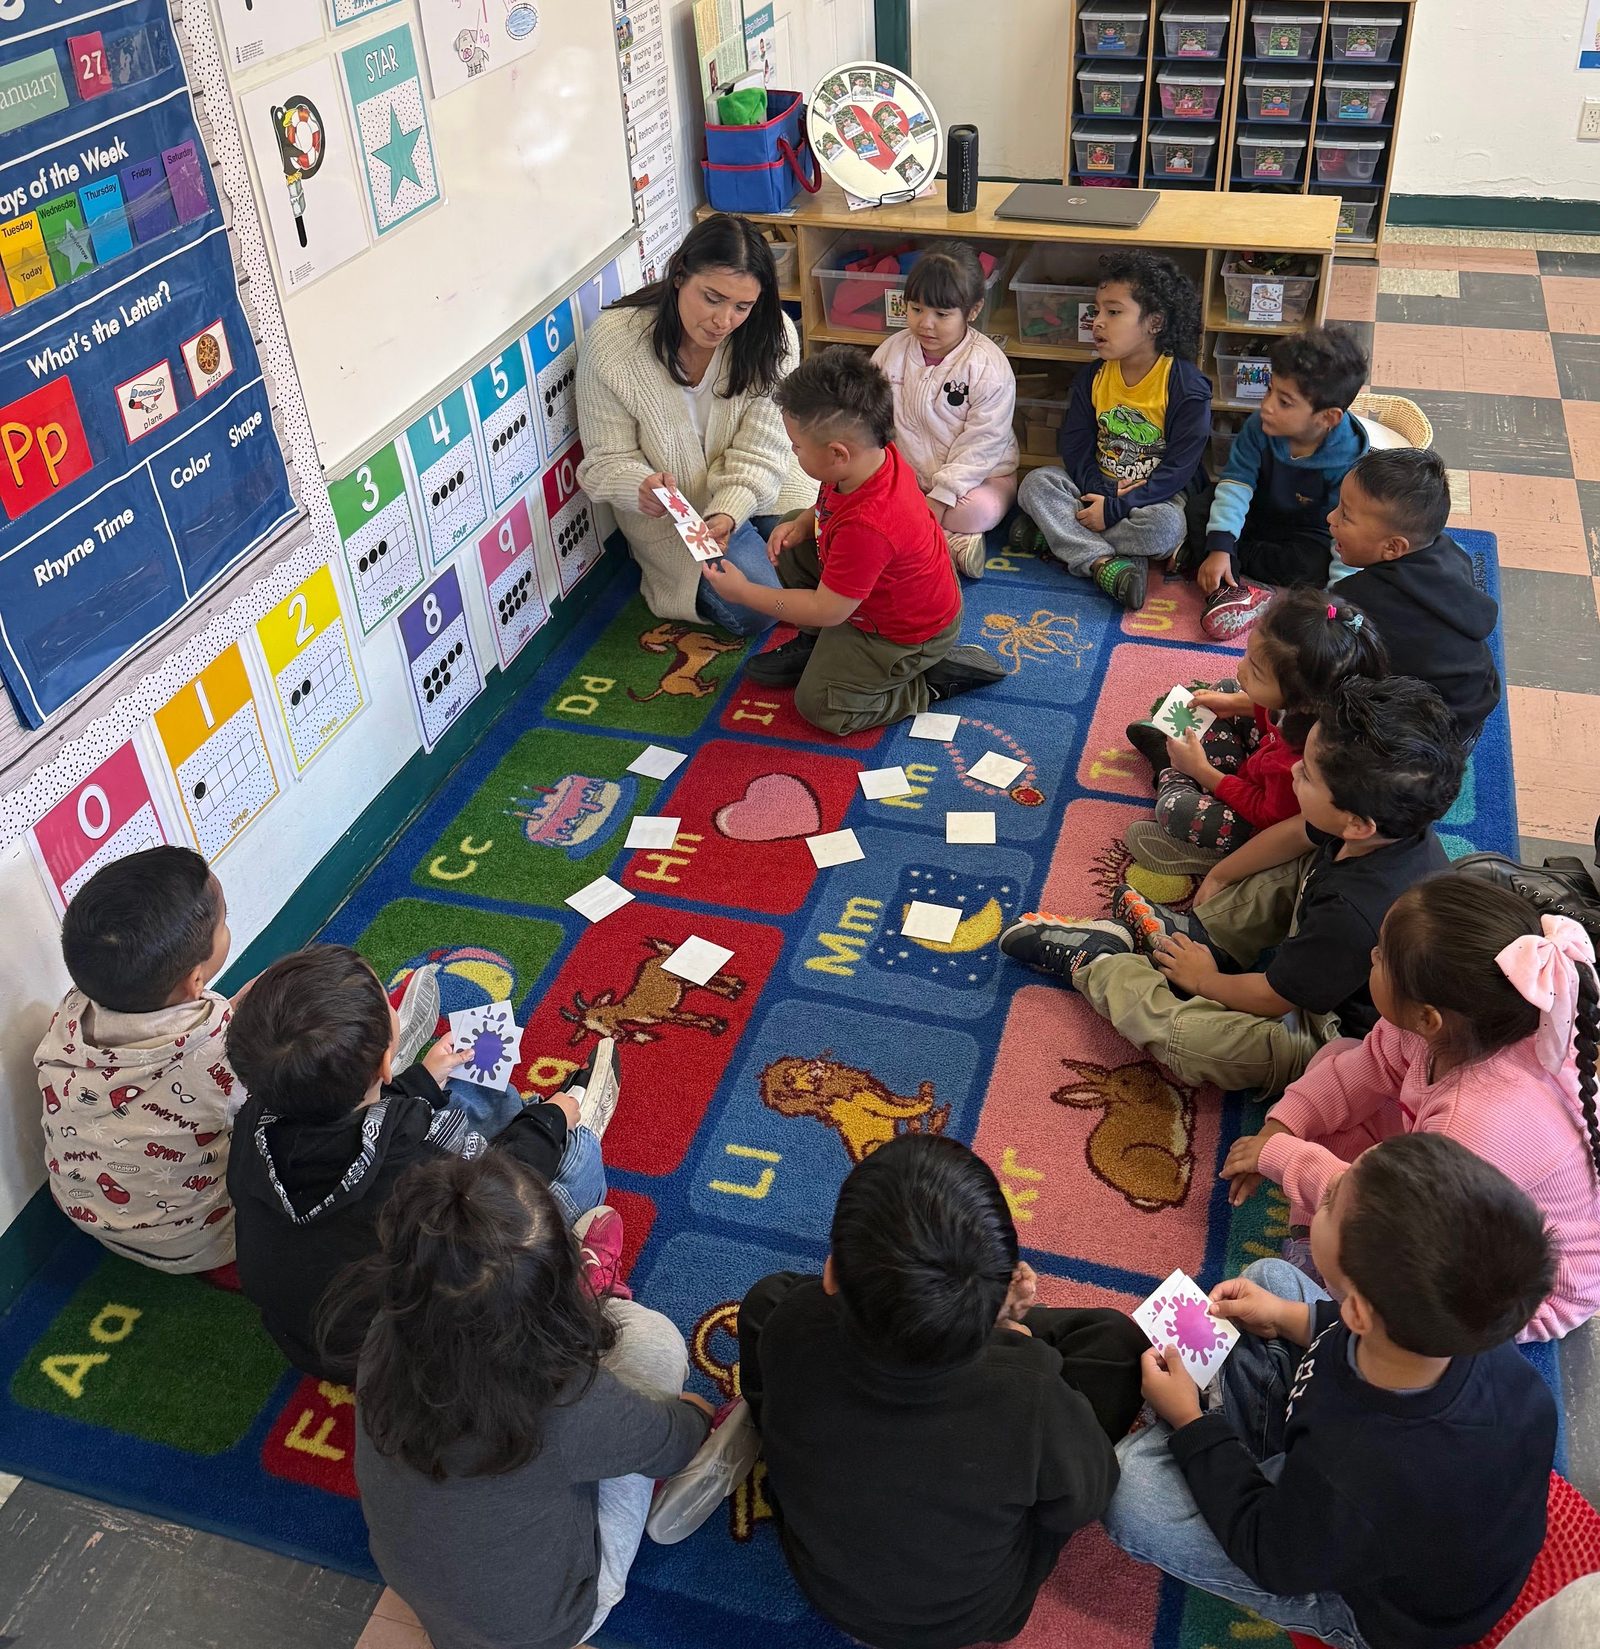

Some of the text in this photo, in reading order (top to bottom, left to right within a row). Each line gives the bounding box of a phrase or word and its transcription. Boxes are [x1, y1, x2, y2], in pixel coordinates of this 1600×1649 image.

[79, 50, 104, 80] 27
[364, 43, 400, 84] STAR
[631, 94, 647, 110] Lunch
[646, 88, 656, 100] Time
[638, 121, 659, 141] Restroom
[30, 168, 50, 198] of
[50, 160, 80, 191] the
[79, 136, 129, 172] Week
[166, 146, 194, 165] Saturday
[646, 154, 656, 166] Time
[131, 166, 153, 181] Friday
[84, 181, 117, 201] Thursday
[646, 188, 666, 208] Restroom
[39, 198, 77, 220] Wednesday
[1, 218, 33, 240] Tuesday
[645, 230, 661, 246] Snack
[659, 222, 669, 236] Time
[655, 246, 673, 266] Outdoor
[20, 264, 43, 283] Today
[26, 281, 172, 379] What's the Letter?
[544, 313, 560, 353] 6
[206, 370, 222, 386] pizza
[489, 355, 508, 399] 5
[143, 412, 163, 430] plane
[228, 410, 262, 447] Shape
[428, 402, 450, 446] 4
[0, 421, 68, 488] Pp
[170, 452, 213, 489] Color
[356, 464, 380, 512] 3
[509, 470, 524, 486] five
[554, 457, 576, 502] 10
[33, 507, 135, 588] Rhyme Time
[451, 523, 468, 543] four
[498, 517, 516, 556] 9
[380, 584, 404, 612] three
[422, 592, 443, 635] 8
[287, 593, 316, 648] 2
[1130, 598, 1179, 632] Uu
[193, 679, 216, 730] 1
[443, 696, 462, 720] eight
[556, 675, 618, 717] Dd
[732, 698, 781, 726] Ii
[77, 783, 111, 840] 0
[229, 808, 249, 831] one
[428, 834, 493, 881] Cc
[803, 896, 884, 978] Mm
[143, 1142, 187, 1163] SPIDEY
[39, 1302, 143, 1400] Aa
